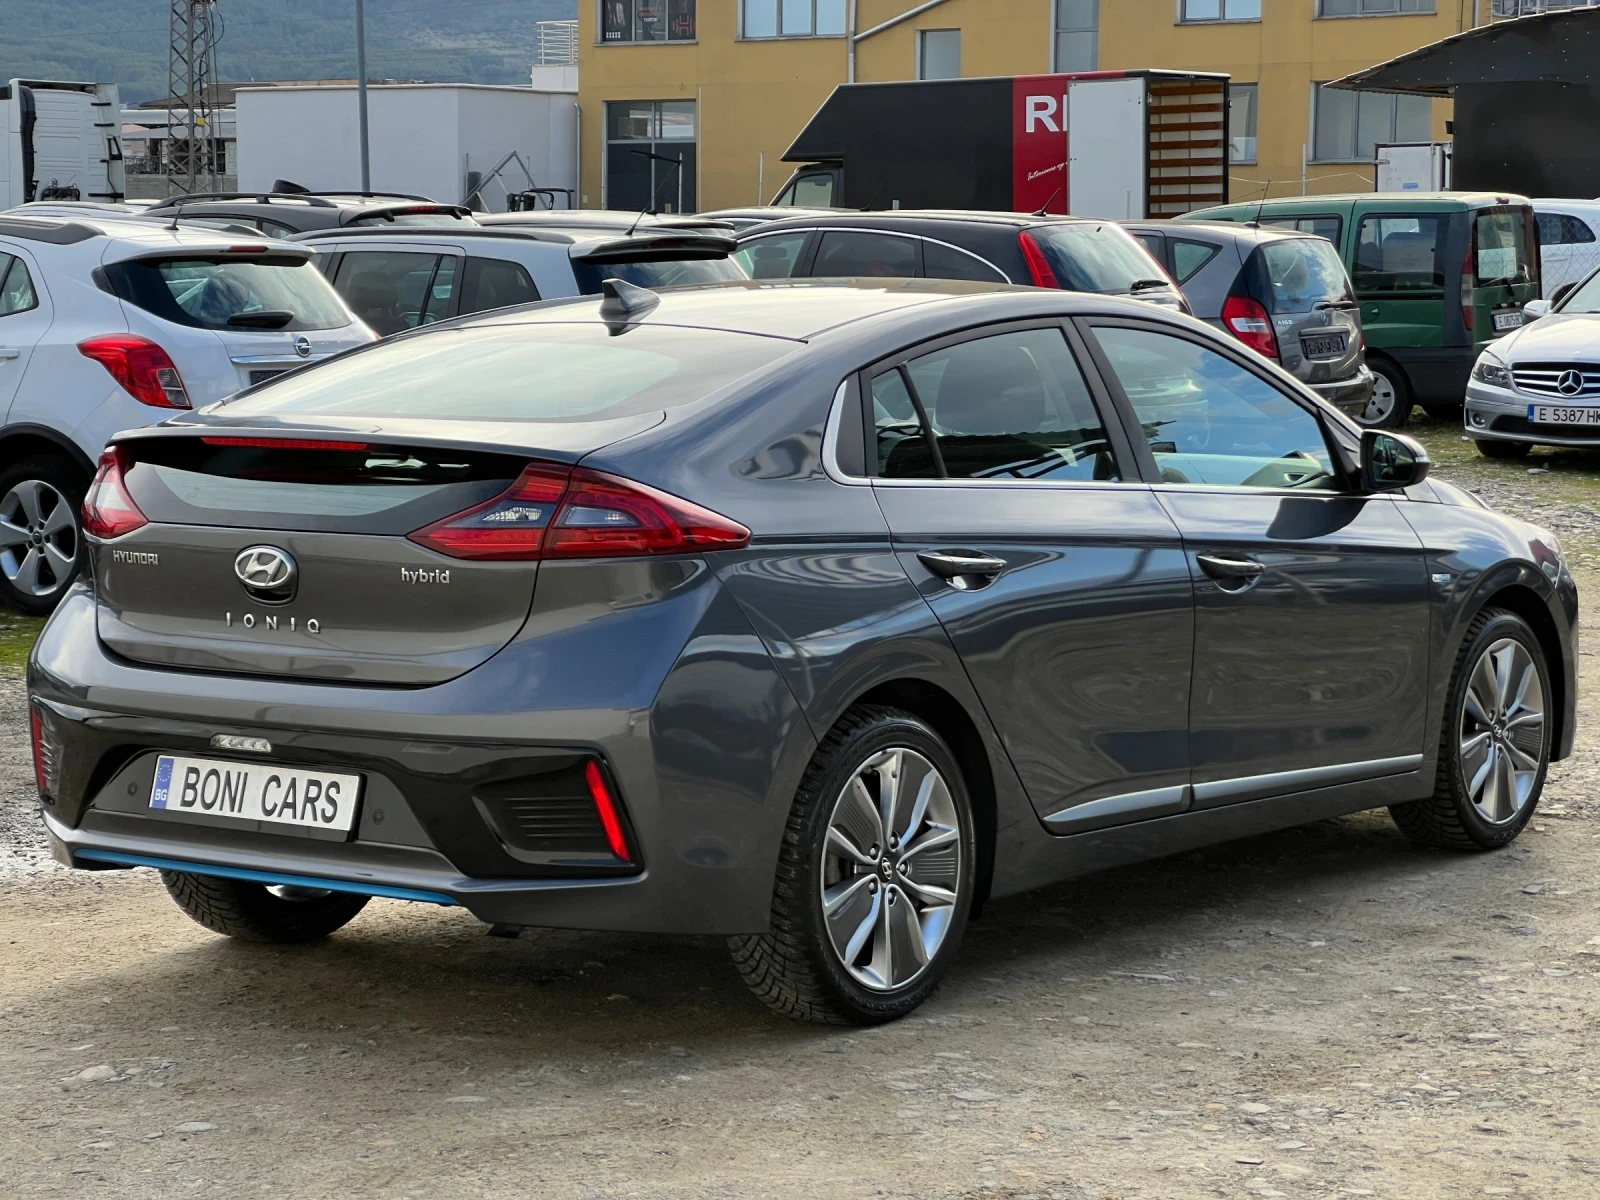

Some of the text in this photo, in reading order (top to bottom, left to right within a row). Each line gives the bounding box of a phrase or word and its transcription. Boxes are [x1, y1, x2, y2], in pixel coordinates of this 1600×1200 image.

[1552, 408, 1585, 423] 5387
[113, 550, 159, 566] HYUNDAI
[401, 567, 450, 585] hybrid
[226, 612, 320, 634] IONIQ
[154, 788, 168, 801] BG
[180, 766, 341, 824] BONI CARS
